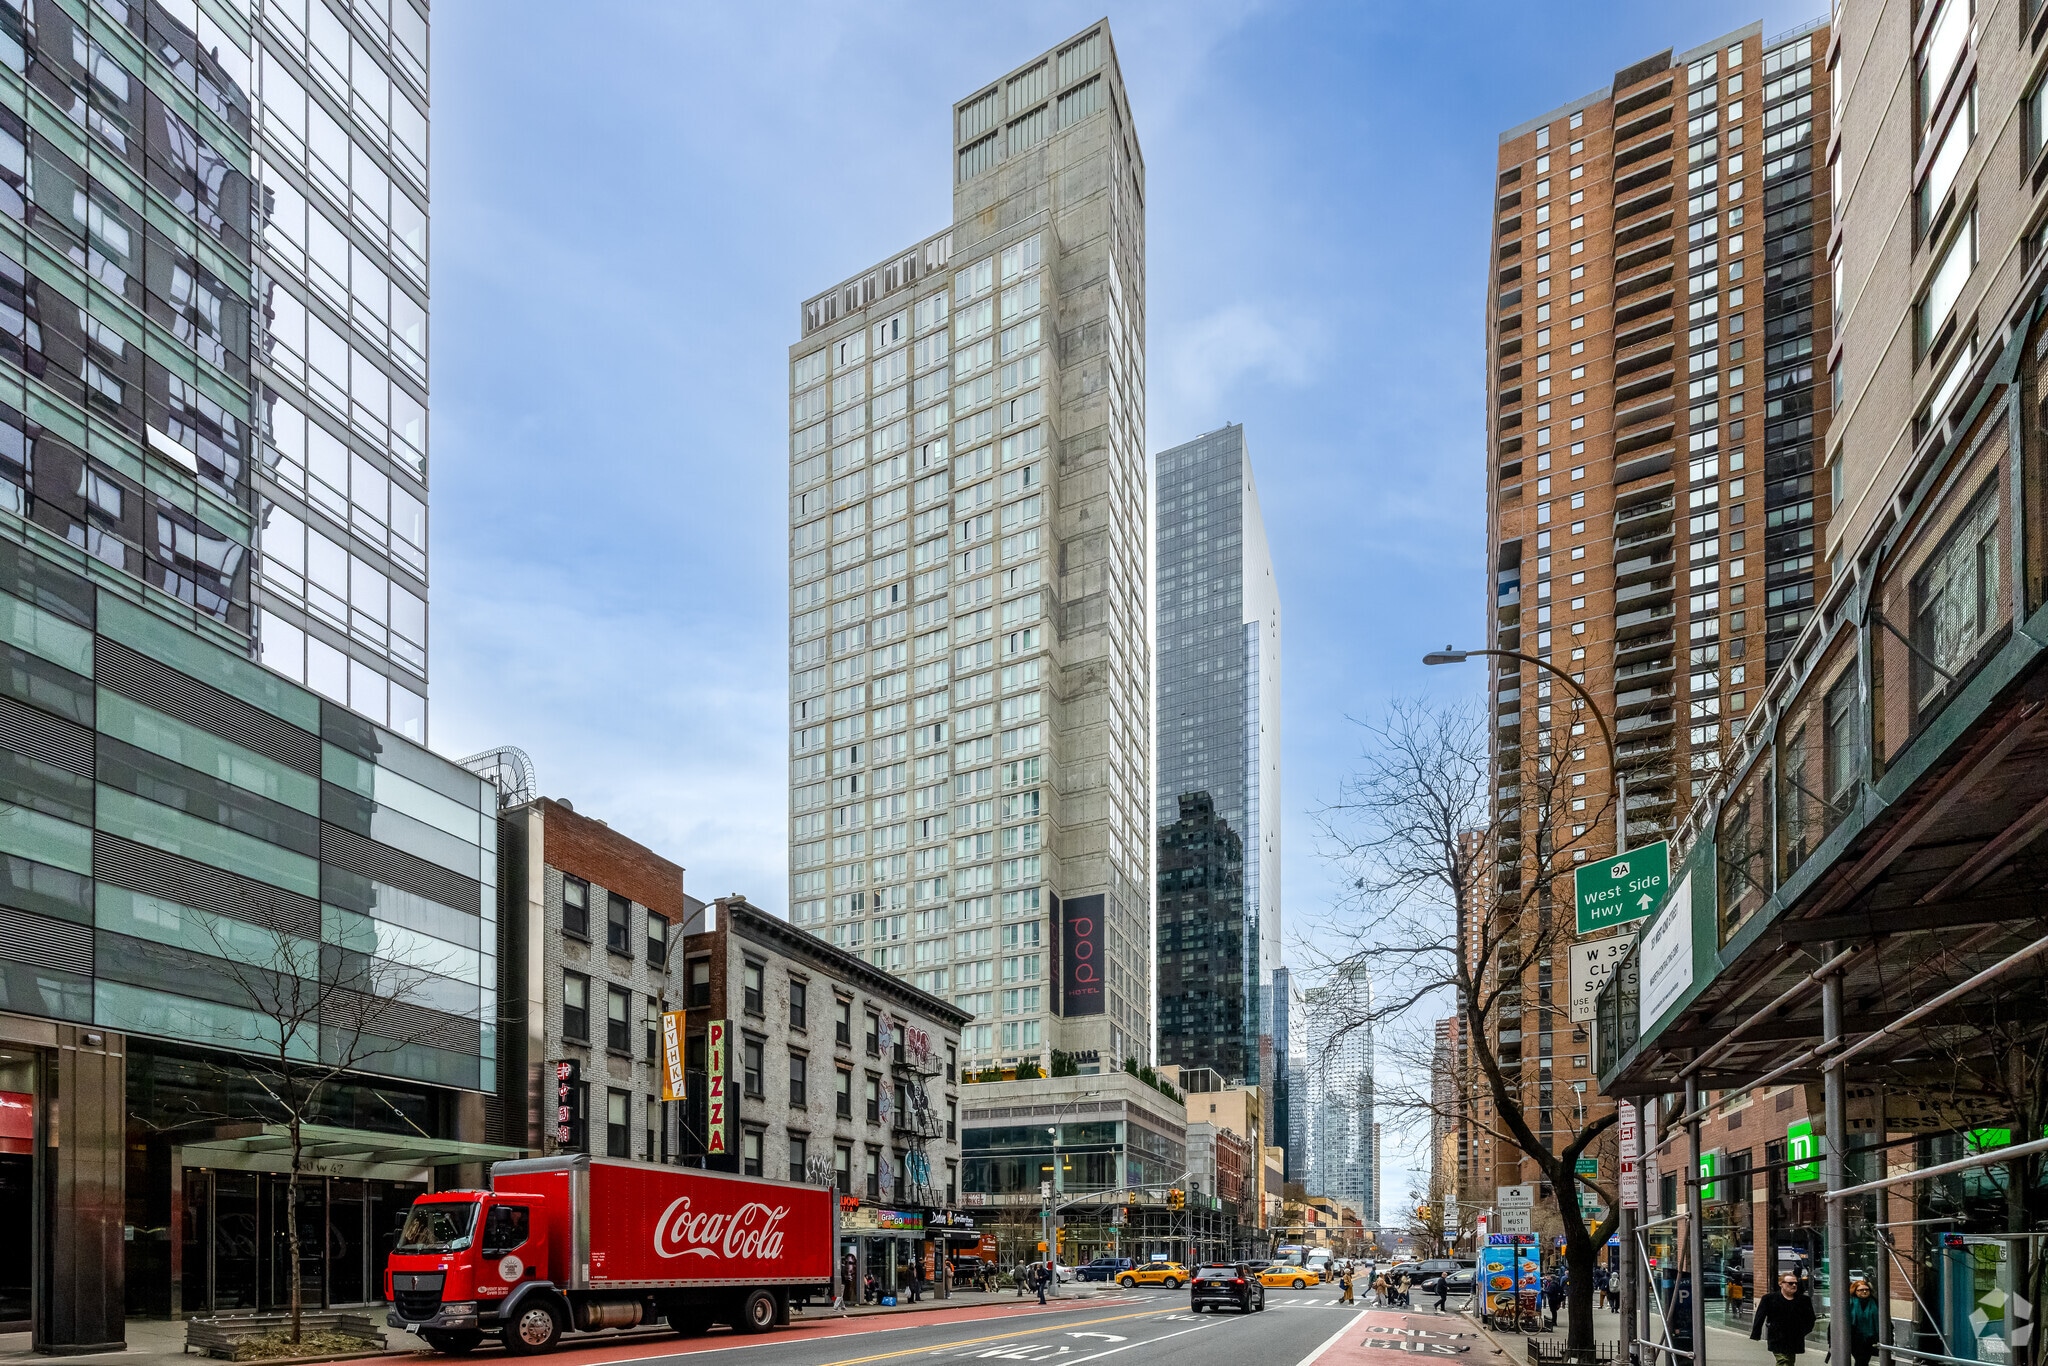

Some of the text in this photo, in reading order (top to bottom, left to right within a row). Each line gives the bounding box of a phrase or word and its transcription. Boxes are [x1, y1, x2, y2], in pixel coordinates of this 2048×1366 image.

[1612, 864, 1629, 877] 9A
[1584, 875, 1660, 905] West Side
[1591, 902, 1624, 920] Hwy
[1068, 917, 1100, 983] pod
[1586, 943, 1629, 961] W 39
[1589, 957, 1640, 976] CLOSE
[1068, 987, 1100, 996] HOTEL
[1573, 997, 1589, 1006] USE
[1579, 1006, 1589, 1014] TO
[709, 1025, 724, 1151] PIZZA
[1790, 1135, 1811, 1171] TD
[330, 1163, 344, 1174] 42
[654, 1196, 790, 1259] Coca-Cola
[1679, 1290, 1690, 1304] P
[1367, 1326, 1465, 1340] ONLY
[1364, 1338, 1459, 1355] BUS
